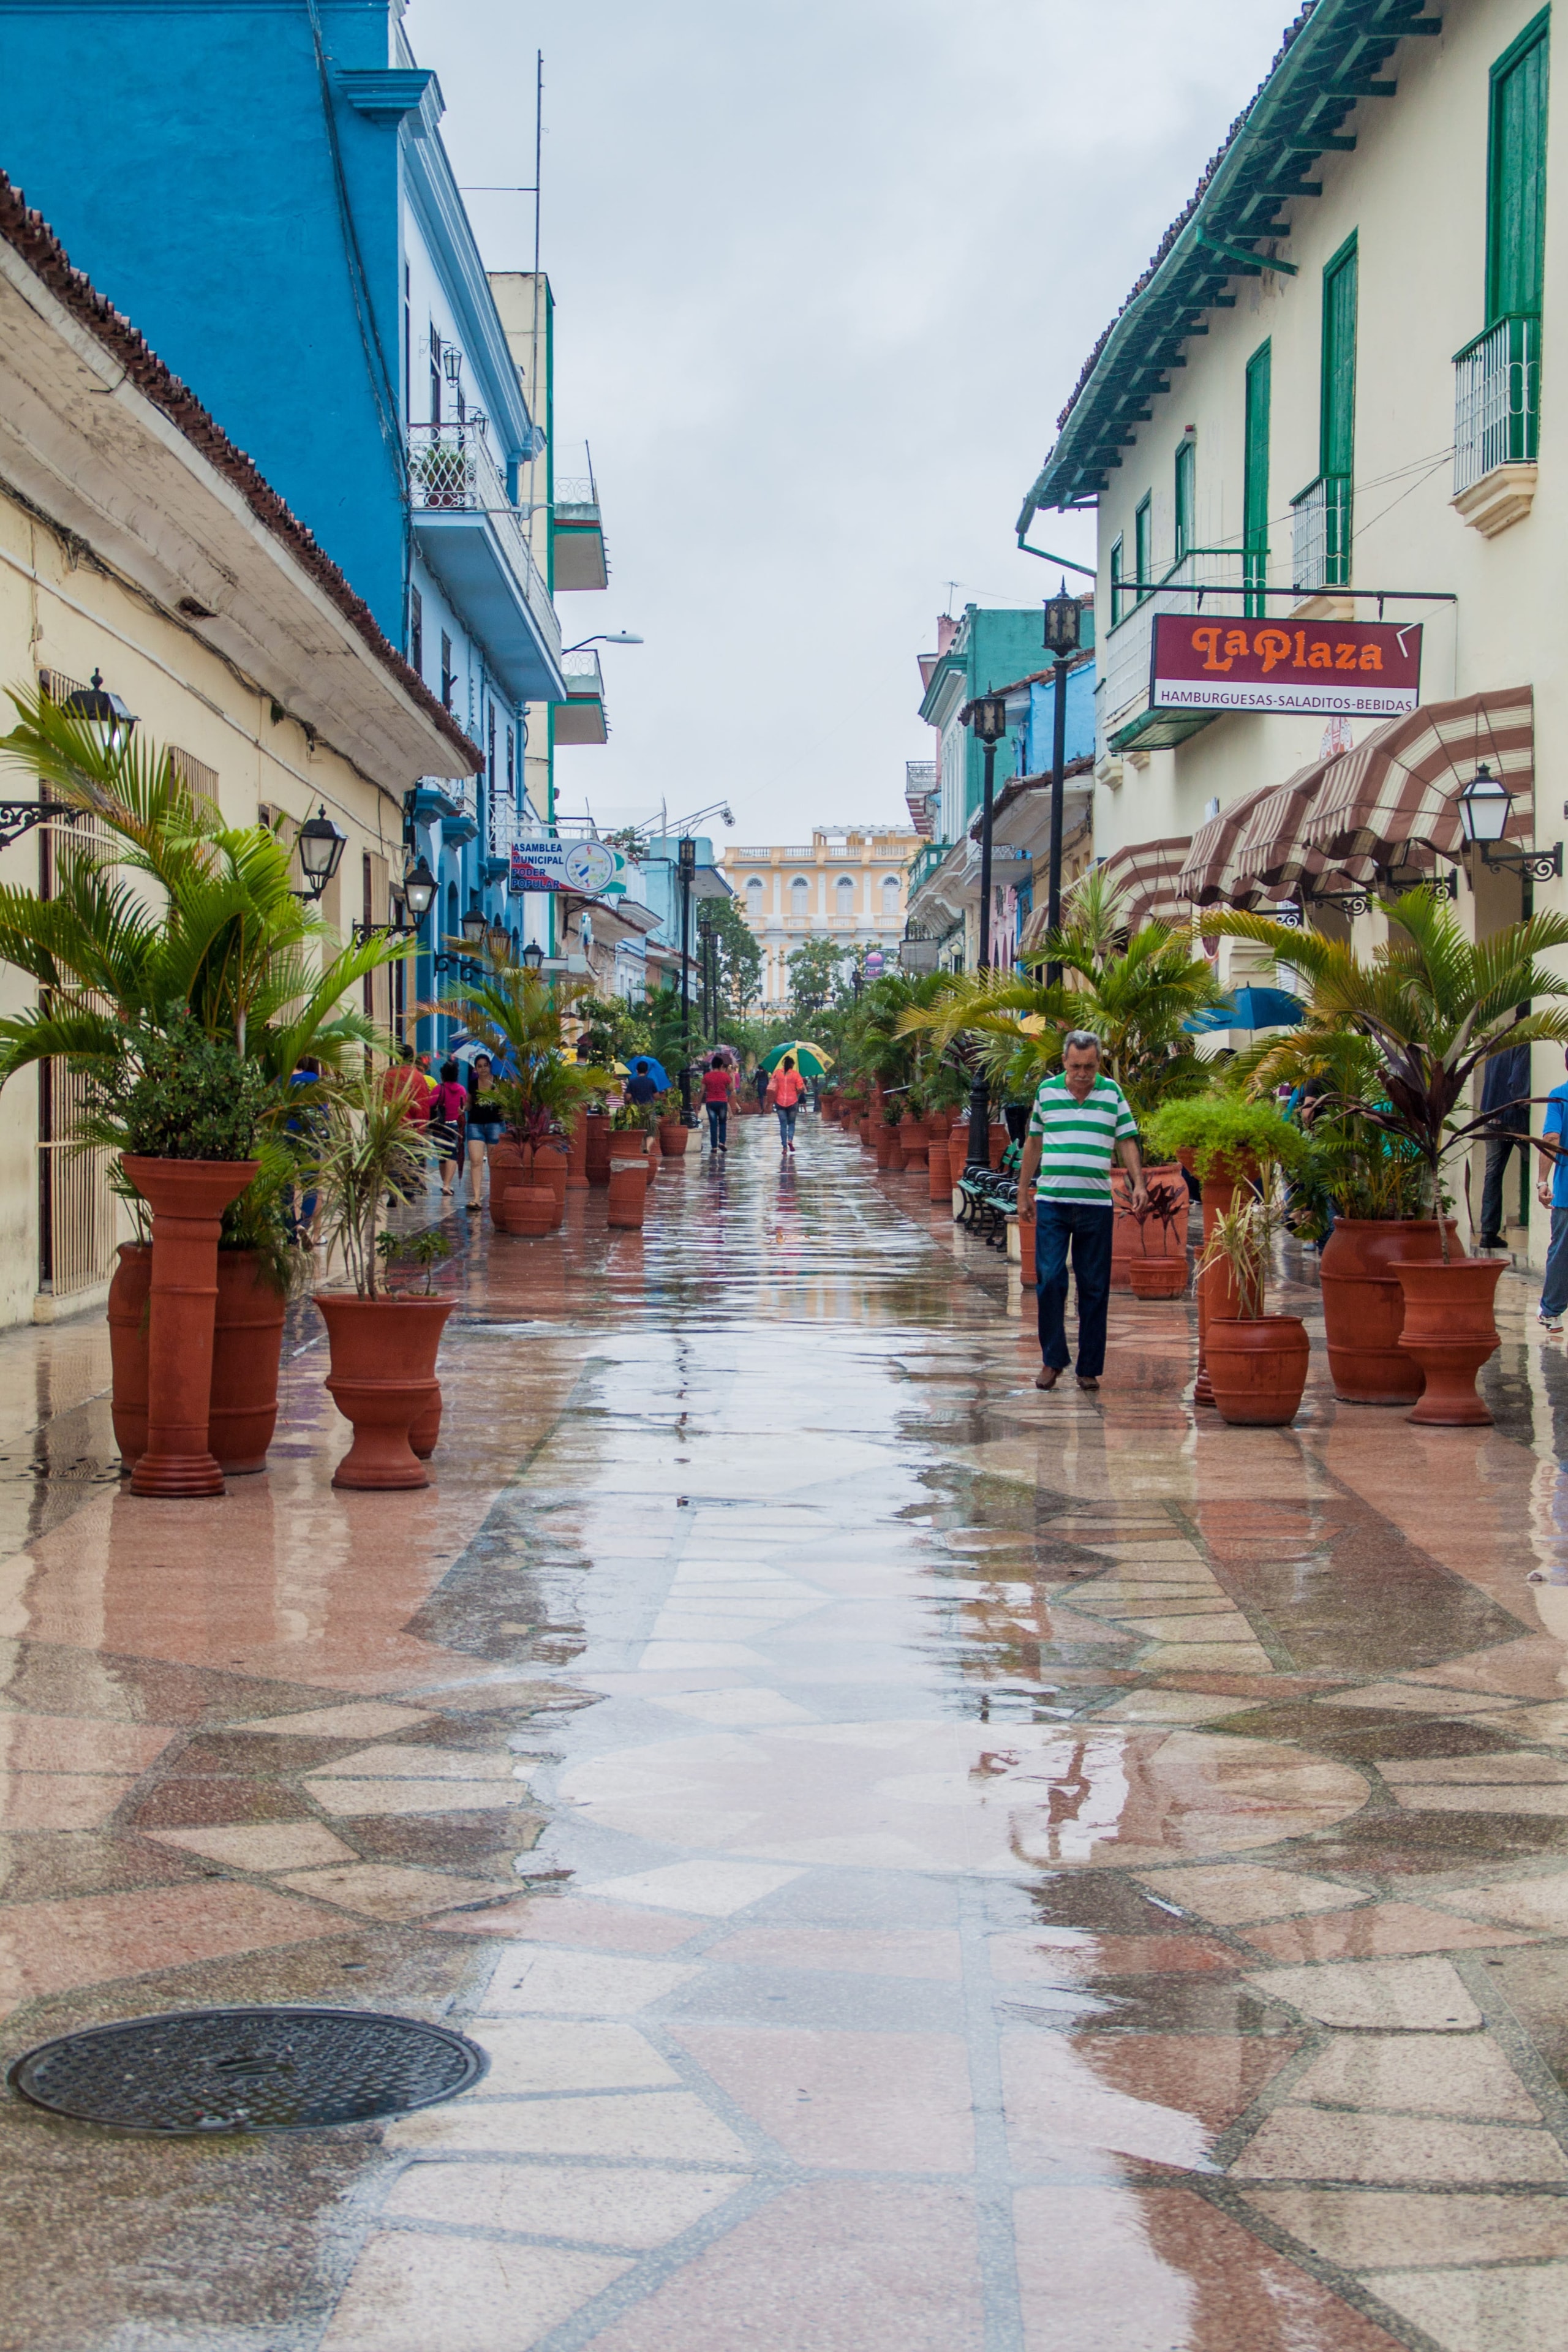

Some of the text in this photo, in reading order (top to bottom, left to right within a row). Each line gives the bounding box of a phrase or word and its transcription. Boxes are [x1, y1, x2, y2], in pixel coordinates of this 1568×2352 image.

[513, 843, 563, 853] ASAMBLEA
[513, 856, 564, 865] MUNICIPAL
[511, 867, 546, 876] PODER
[511, 879, 560, 889] POPULAR
